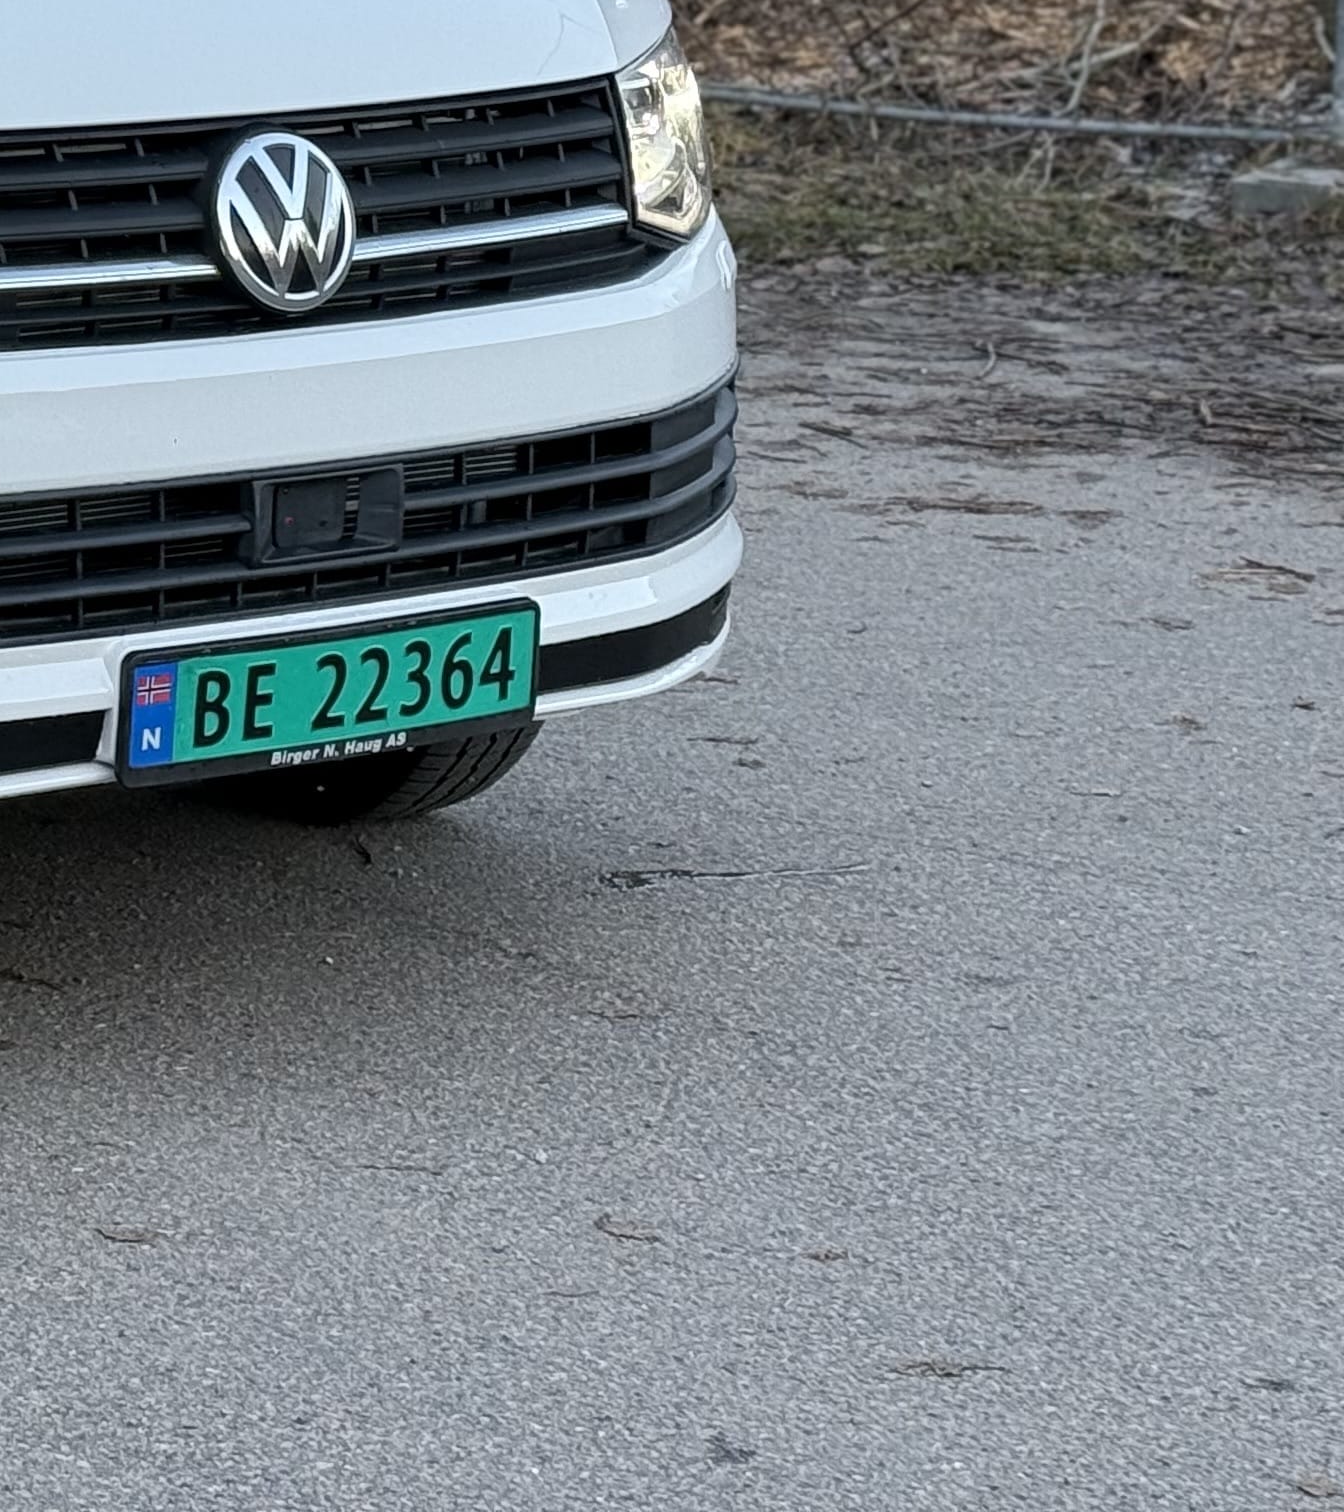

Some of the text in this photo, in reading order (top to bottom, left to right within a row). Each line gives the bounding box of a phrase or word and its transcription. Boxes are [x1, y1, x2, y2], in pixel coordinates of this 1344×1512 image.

[217, 132, 355, 305] VW
[191, 627, 517, 750] BE 22364
[142, 725, 161, 751] N
[270, 731, 408, 766] Birger N. Haug AS
